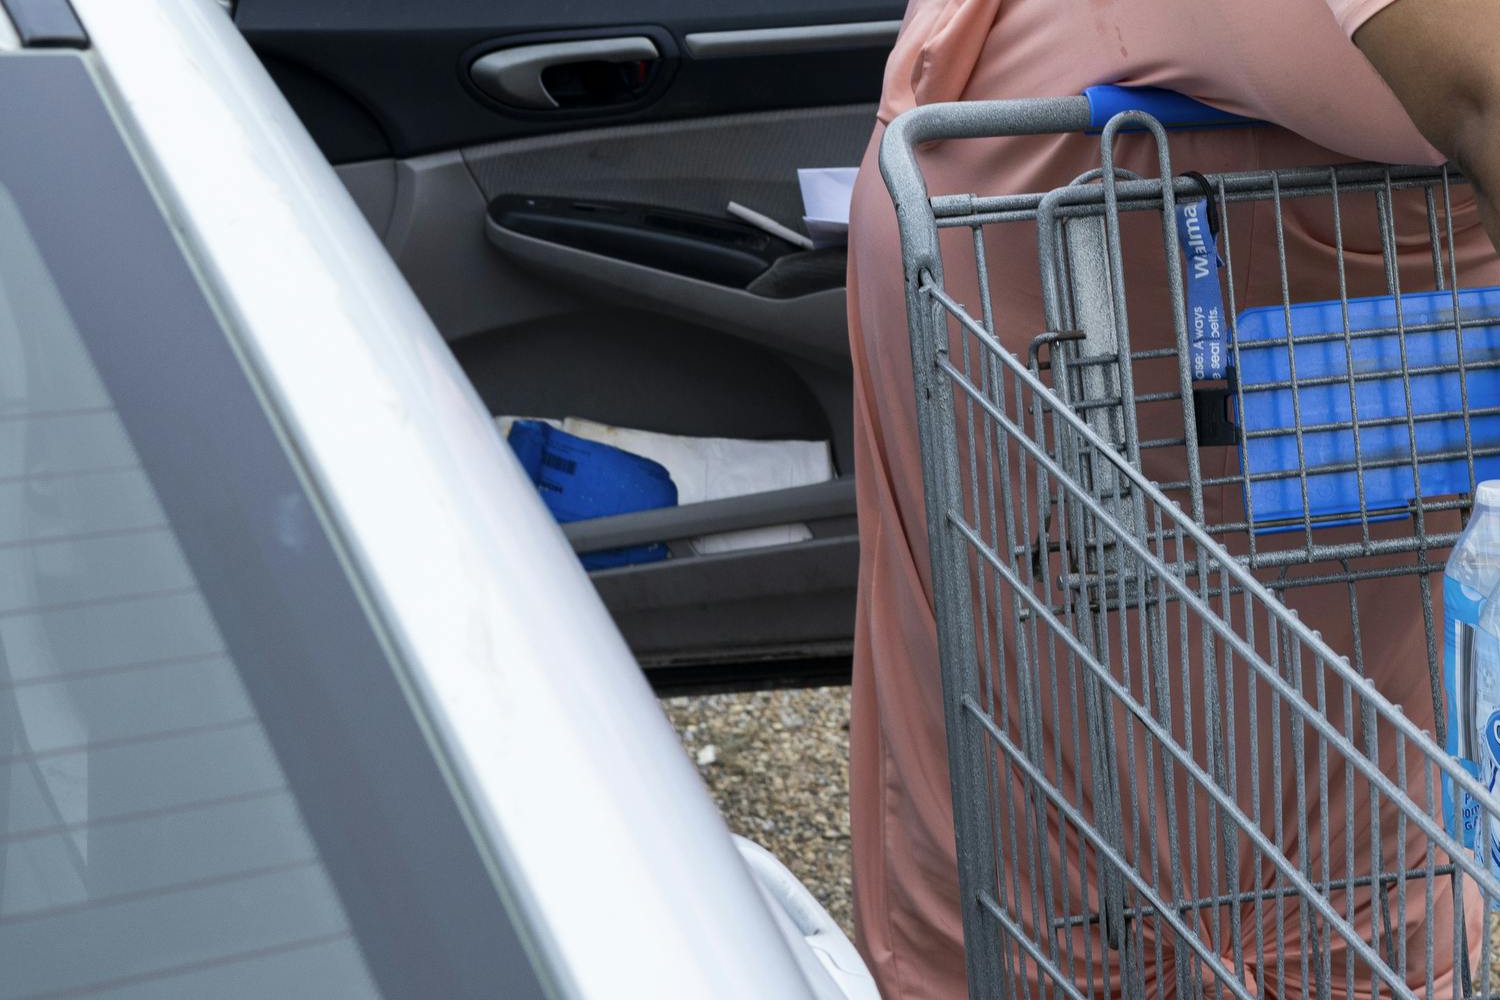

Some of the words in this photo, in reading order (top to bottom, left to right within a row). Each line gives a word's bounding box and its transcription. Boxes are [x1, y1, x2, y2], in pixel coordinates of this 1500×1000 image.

[1184, 203, 1209, 279] Walma
[1193, 306, 1205, 348] Aways
[1195, 351, 1205, 380] ase:
